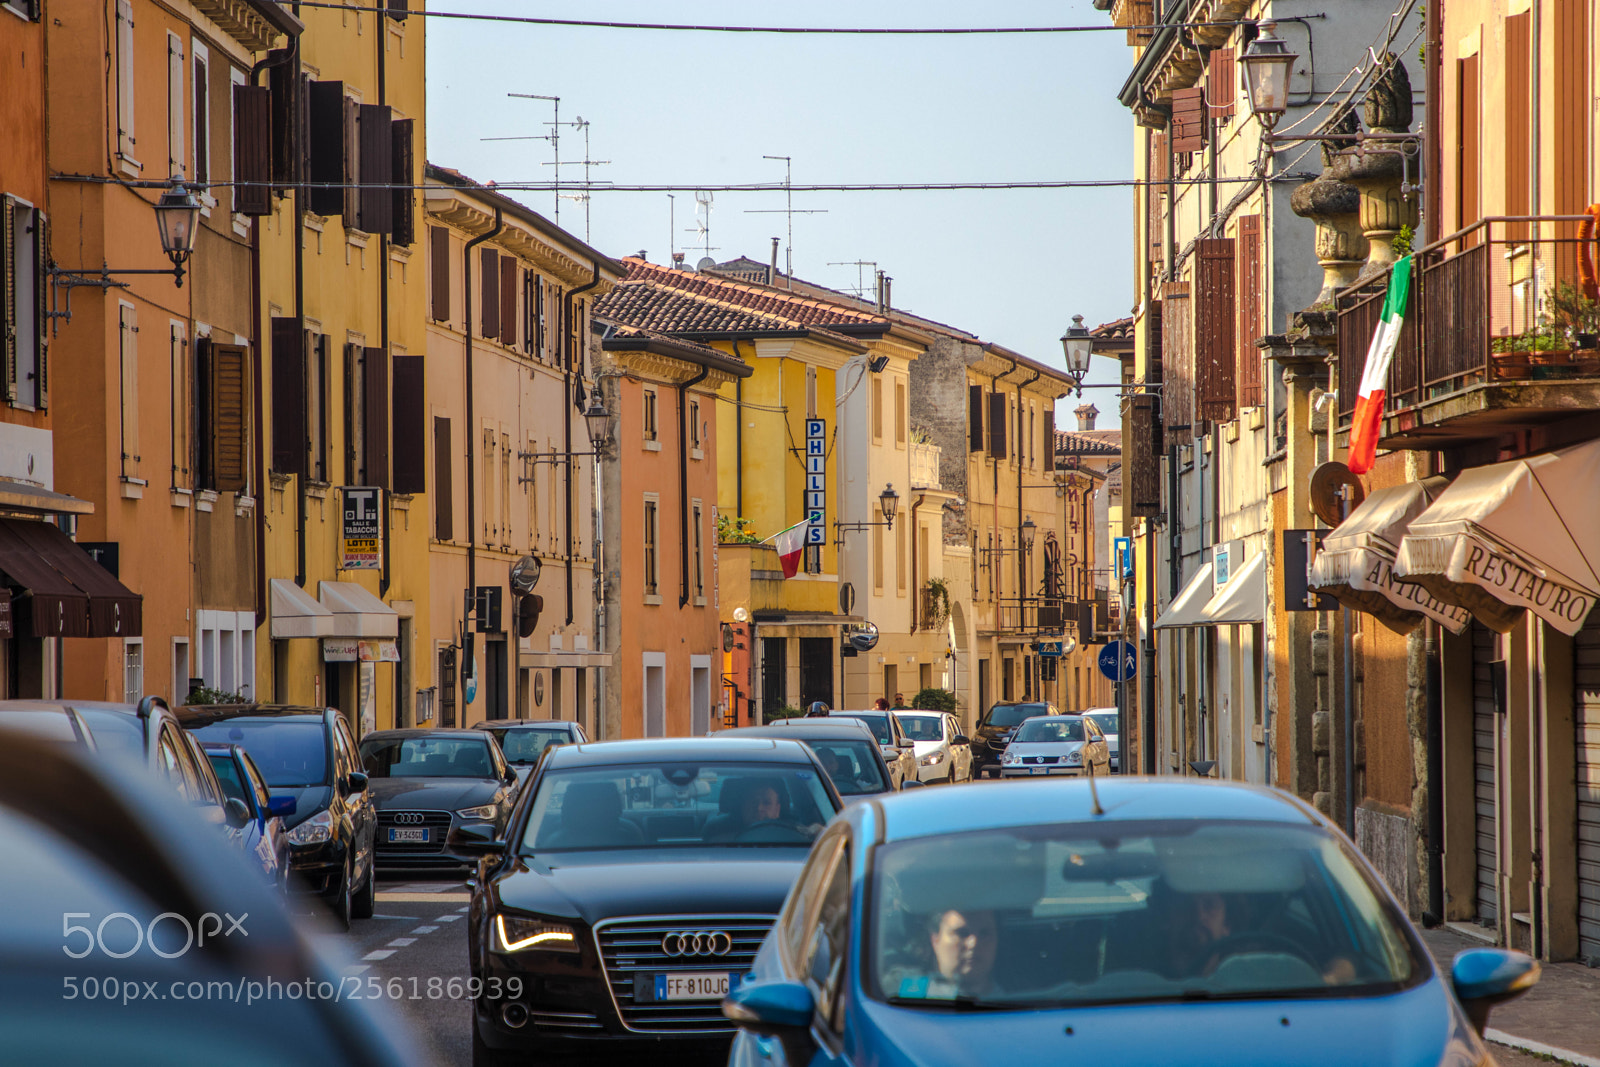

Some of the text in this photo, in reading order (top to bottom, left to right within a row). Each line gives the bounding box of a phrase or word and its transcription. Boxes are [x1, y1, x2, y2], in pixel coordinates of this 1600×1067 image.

[348, 491, 373, 520] T
[810, 423, 821, 541] PHILIPS
[1464, 545, 1588, 622] RESTAURO
